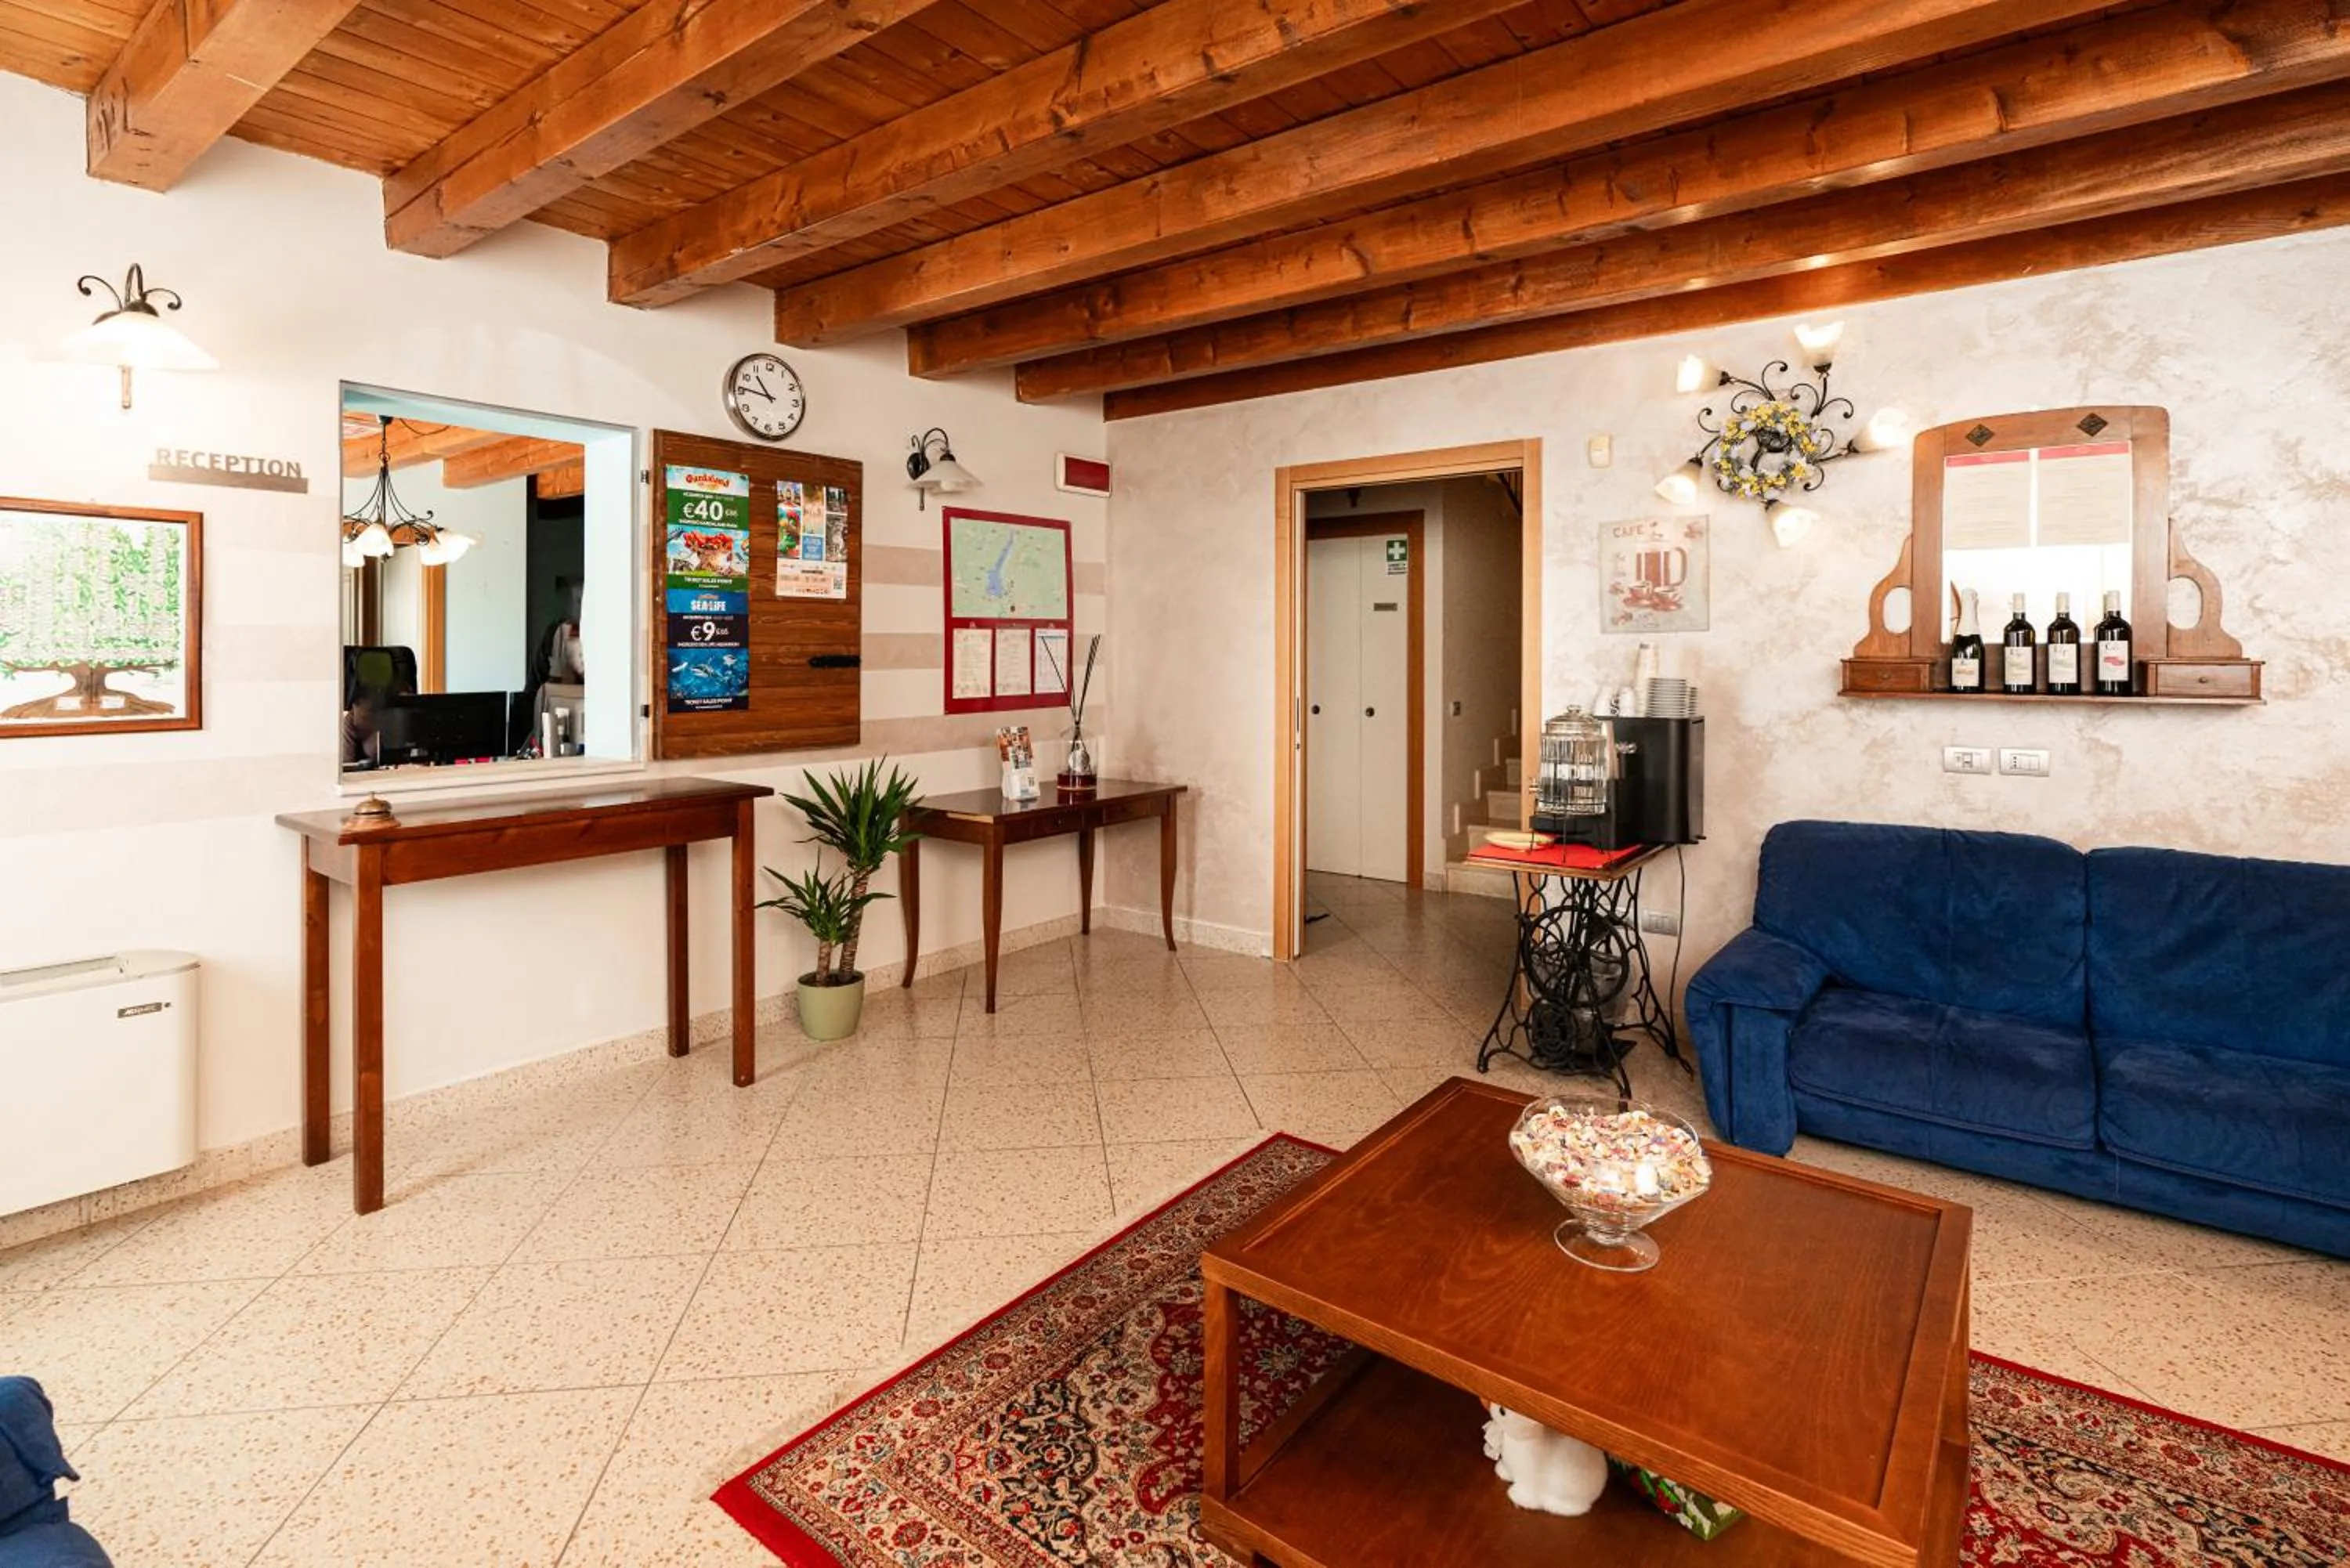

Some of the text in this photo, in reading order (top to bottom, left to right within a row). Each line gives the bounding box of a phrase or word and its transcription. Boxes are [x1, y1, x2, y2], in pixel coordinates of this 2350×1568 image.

[765, 363, 775, 372] 12
[742, 374, 751, 382] 10
[788, 383, 796, 392] 2
[792, 399, 800, 408] 3
[742, 404, 750, 413] 8
[752, 416, 758, 425] 7
[764, 424, 772, 432] 6
[778, 421, 786, 430] 5
[156, 448, 302, 479] RECEPTION
